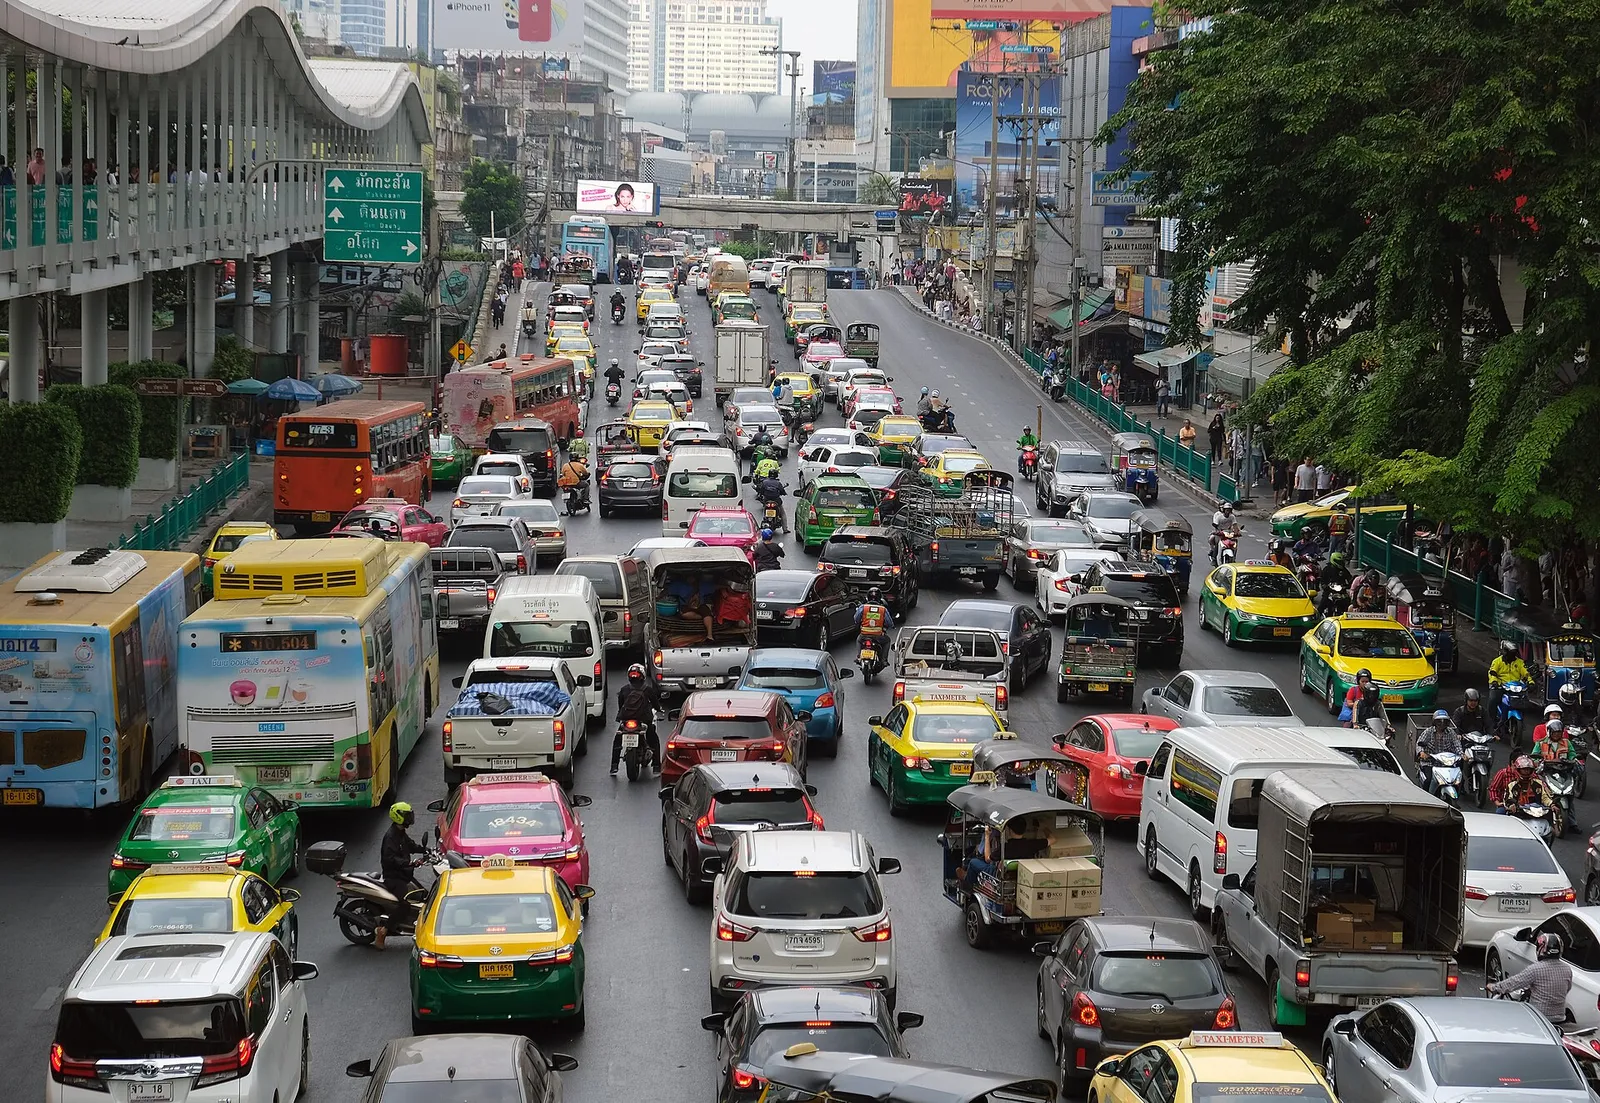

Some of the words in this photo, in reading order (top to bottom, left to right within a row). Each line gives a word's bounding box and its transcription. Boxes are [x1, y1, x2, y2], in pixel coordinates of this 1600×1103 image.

[454, 3, 482, 12] iPhone
[484, 4, 490, 12] 11
[356, 172, 410, 190] มักกะสัน
[359, 203, 406, 219] ดินแดง
[225, 564, 234, 572] 77
[260, 769, 289, 778] 14-4150
[6, 792, 36, 800] 16-1136
[152, 1084, 162, 1094] 18
